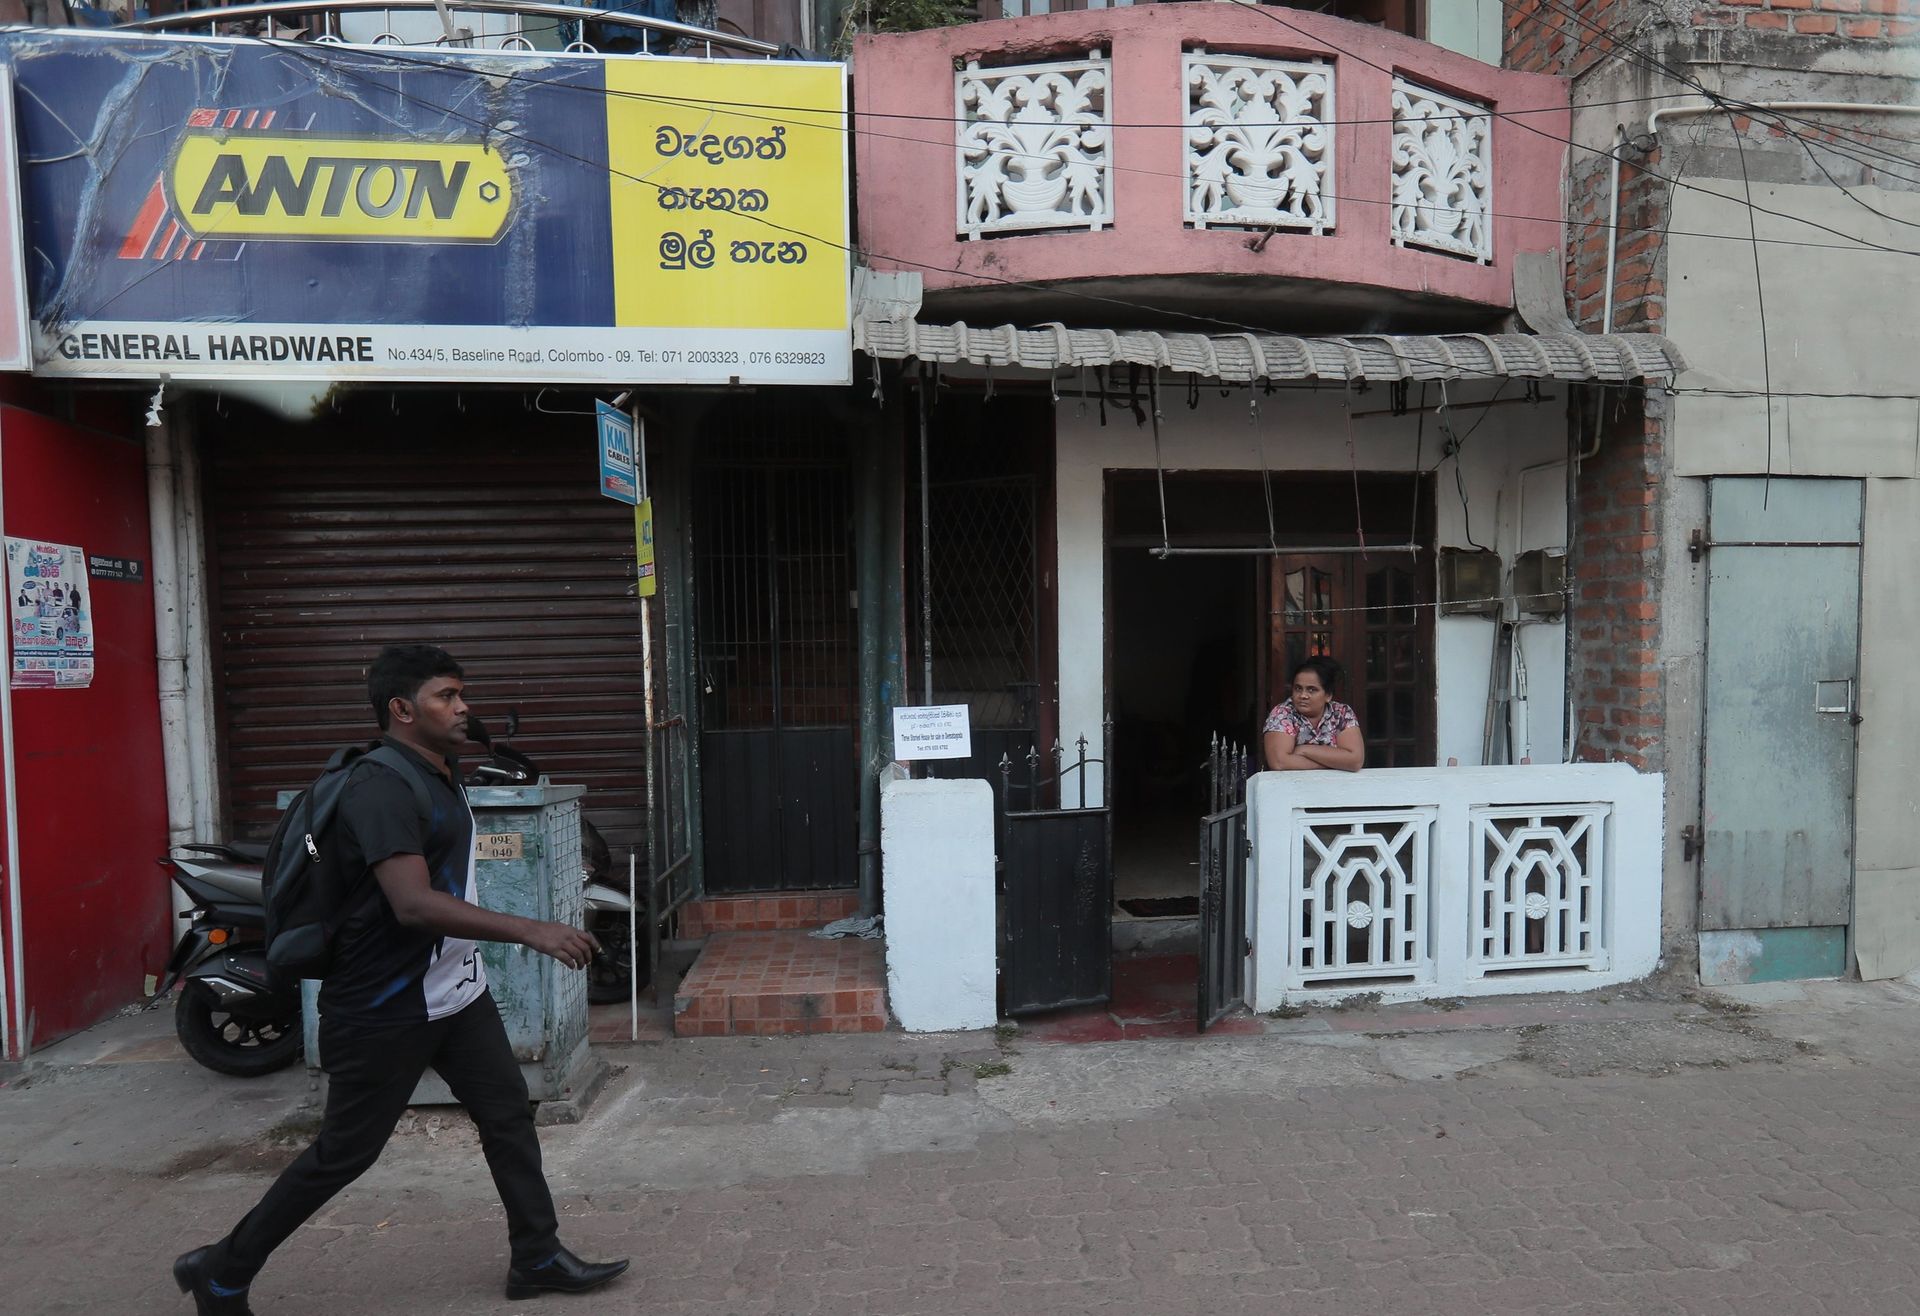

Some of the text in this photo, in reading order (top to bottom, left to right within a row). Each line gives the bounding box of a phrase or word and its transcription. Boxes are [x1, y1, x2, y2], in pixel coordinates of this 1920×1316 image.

[655, 125, 787, 165] වැදගත්
[190, 154, 472, 219] ANTON
[657, 186, 769, 212] තැනක
[659, 229, 808, 270] මුල් තැන
[60, 334, 374, 362] GENERAL HARDWARE
[388, 348, 448, 363] No.434/5,
[452, 349, 505, 362] Baseline
[508, 349, 545, 363] Road,
[548, 349, 605, 362] Colombo
[638, 350, 658, 363] Tel:
[661, 351, 683, 363] 071
[687, 351, 739, 364] 2003323
[750, 351, 772, 364] 076
[774, 352, 826, 365] 6329823
[606, 423, 630, 457] KML
[607, 449, 631, 466] CABLES
[490, 835, 513, 845] 09E
[492, 847, 513, 858] 040
